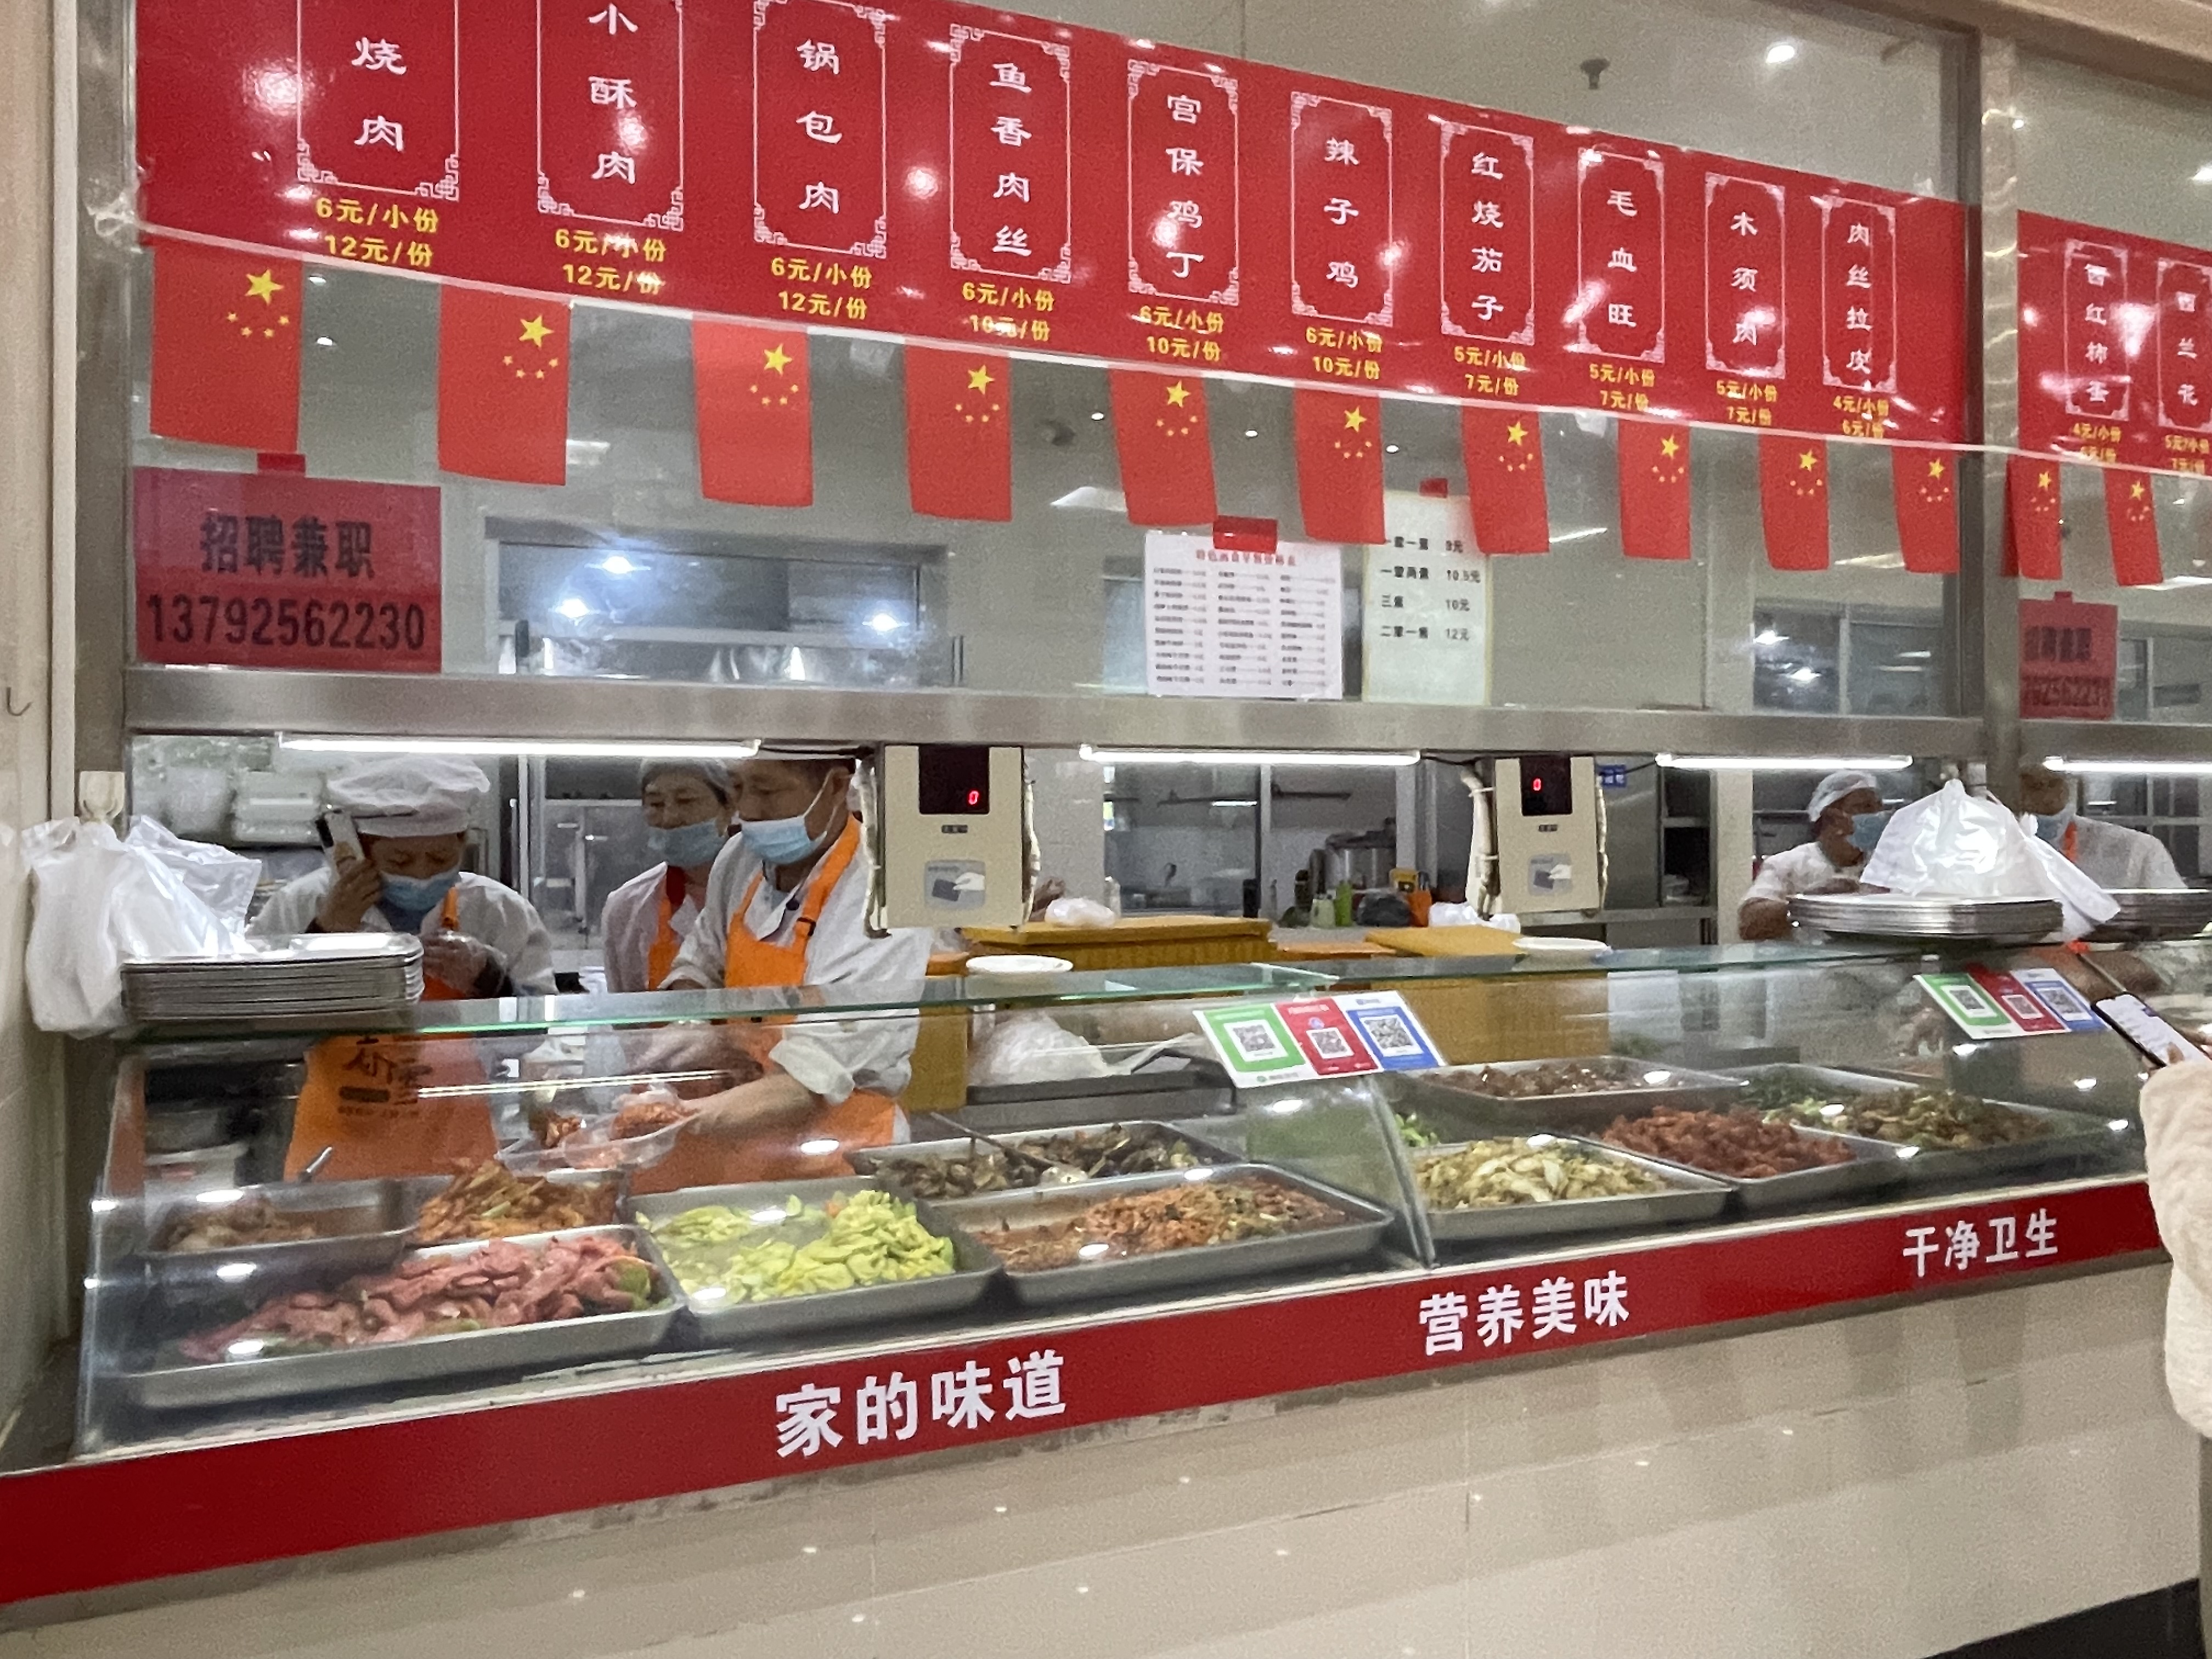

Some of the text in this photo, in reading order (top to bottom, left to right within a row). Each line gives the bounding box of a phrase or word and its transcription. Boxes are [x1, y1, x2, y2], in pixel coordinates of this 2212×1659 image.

[351, 37, 407, 151] 烧肉
[588, 4, 638, 184] 小酥肉
[796, 39, 842, 213] 锅包肉
[990, 63, 1032, 257] 鱼香肉丝
[1165, 94, 1204, 277] 宫保鸡丁
[315, 198, 439, 233] 6元/小份
[1324, 138, 1359, 289] 辣子鸡
[324, 235, 433, 267] 12元/份
[554, 229, 667, 262] 6元/小份
[1471, 153, 1503, 320] 红烧茄子
[771, 258, 872, 289] 6元/小份
[1607, 190, 1638, 328] 毛血旺
[563, 263, 664, 295] 12元/份
[1730, 212, 1758, 345] 木须肉
[778, 291, 868, 320] 12元/份
[962, 282, 1055, 312] 6元/小份
[1846, 223, 1872, 374] 肉丝拉皮
[1139, 306, 1224, 334] 6元/小份
[1147, 336, 1221, 360] 10元/份
[1306, 327, 1383, 352] 6元/小份
[1313, 356, 1380, 380] 10元/份
[1465, 374, 1519, 396] 7元/份
[1589, 363, 1655, 387] 5元/小份
[1600, 390, 1649, 411] 7元/份
[1726, 406, 1771, 425] 7元/份
[200, 514, 375, 579] 招聘兼职
[146, 594, 425, 651] 13792562230
[968, 790, 980, 805] 0
[1533, 778, 1542, 791] 0
[1903, 1208, 2058, 1277] 干净卫生
[1419, 1270, 1630, 1356] 营养美味
[776, 1349, 1066, 1458] 家的味道
